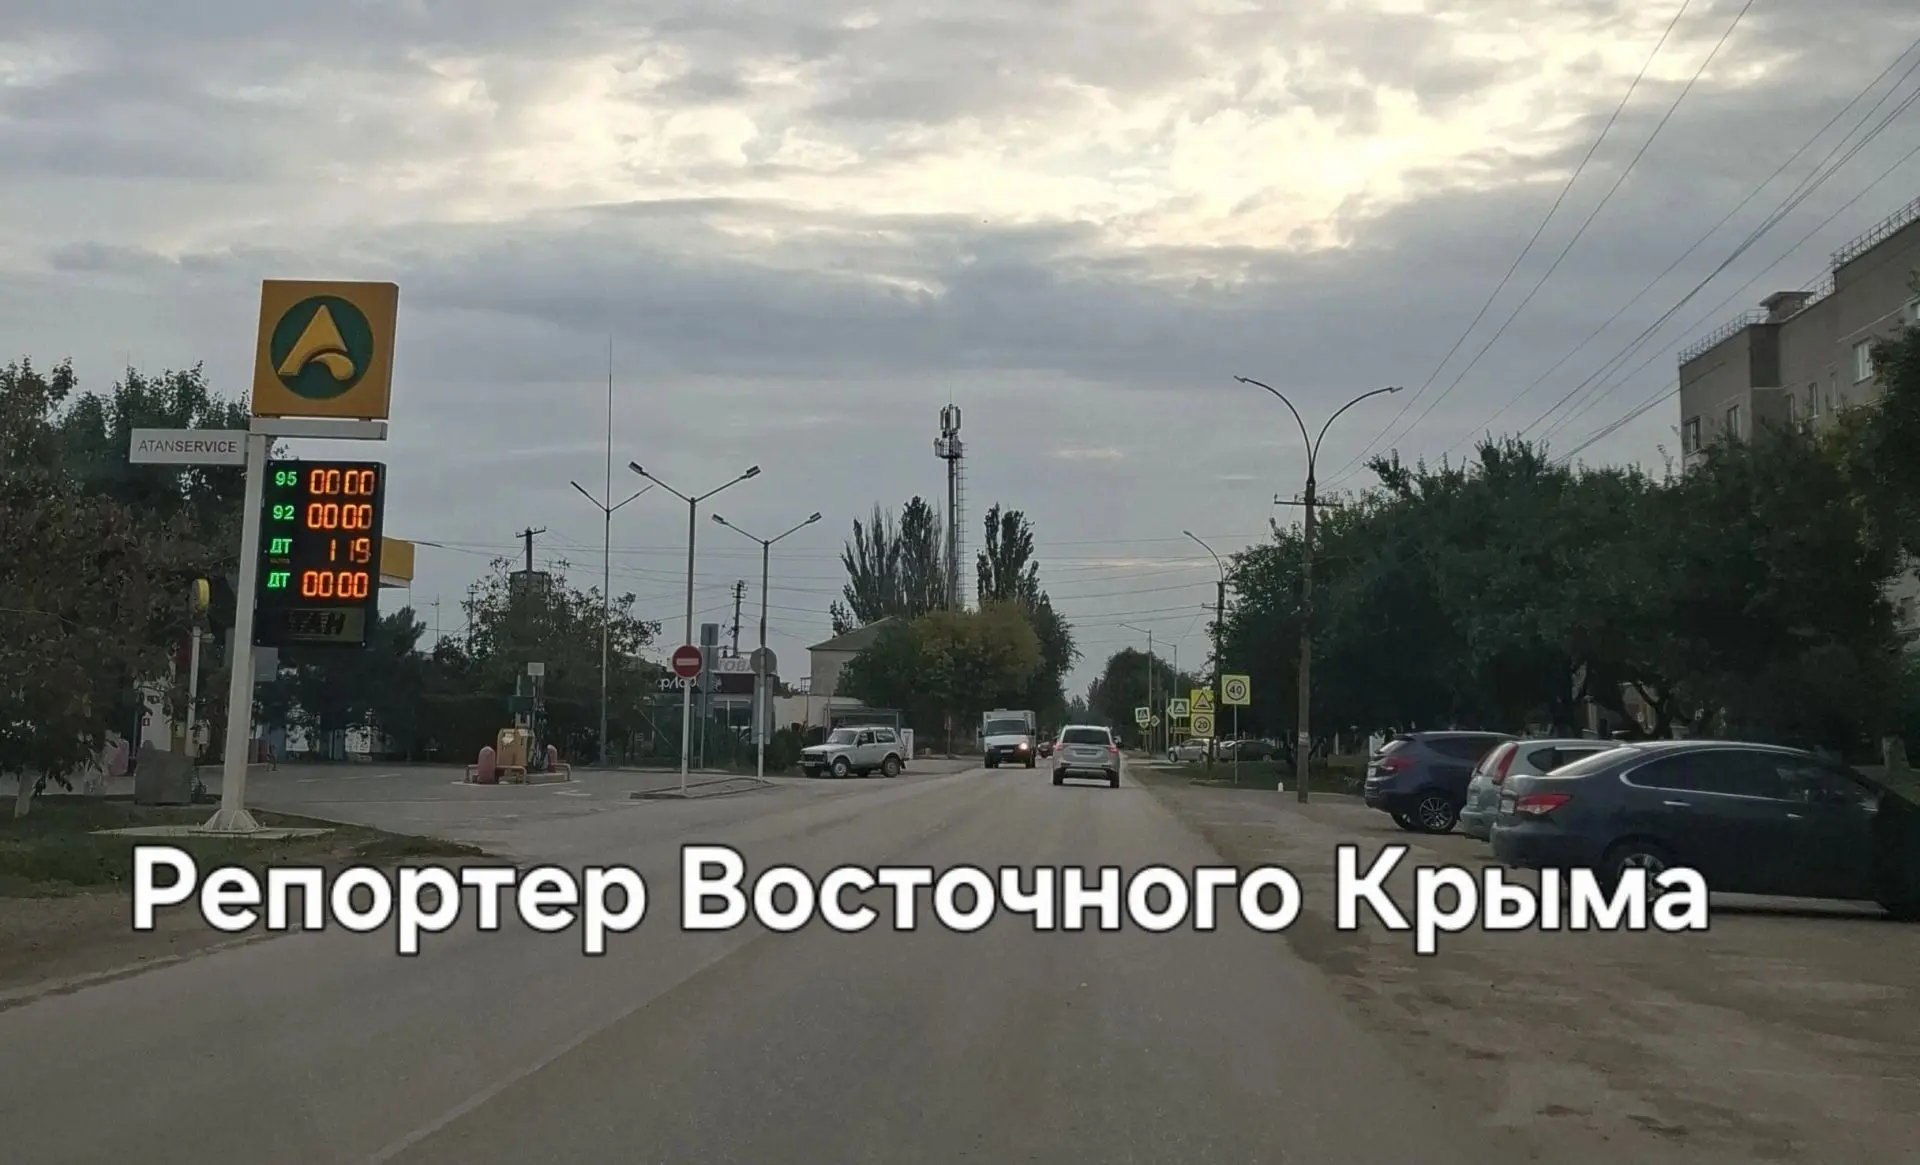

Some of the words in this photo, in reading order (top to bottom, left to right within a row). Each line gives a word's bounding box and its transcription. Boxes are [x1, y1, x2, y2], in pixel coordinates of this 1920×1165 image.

[138, 440, 238, 453] ATANSERVICE
[275, 471, 298, 486] 95
[272, 504, 295, 520] 92
[269, 538, 293, 554] ДТ
[267, 572, 291, 588] ДТ
[1229, 685, 1243, 694] 40
[1197, 720, 1208, 729] 20
